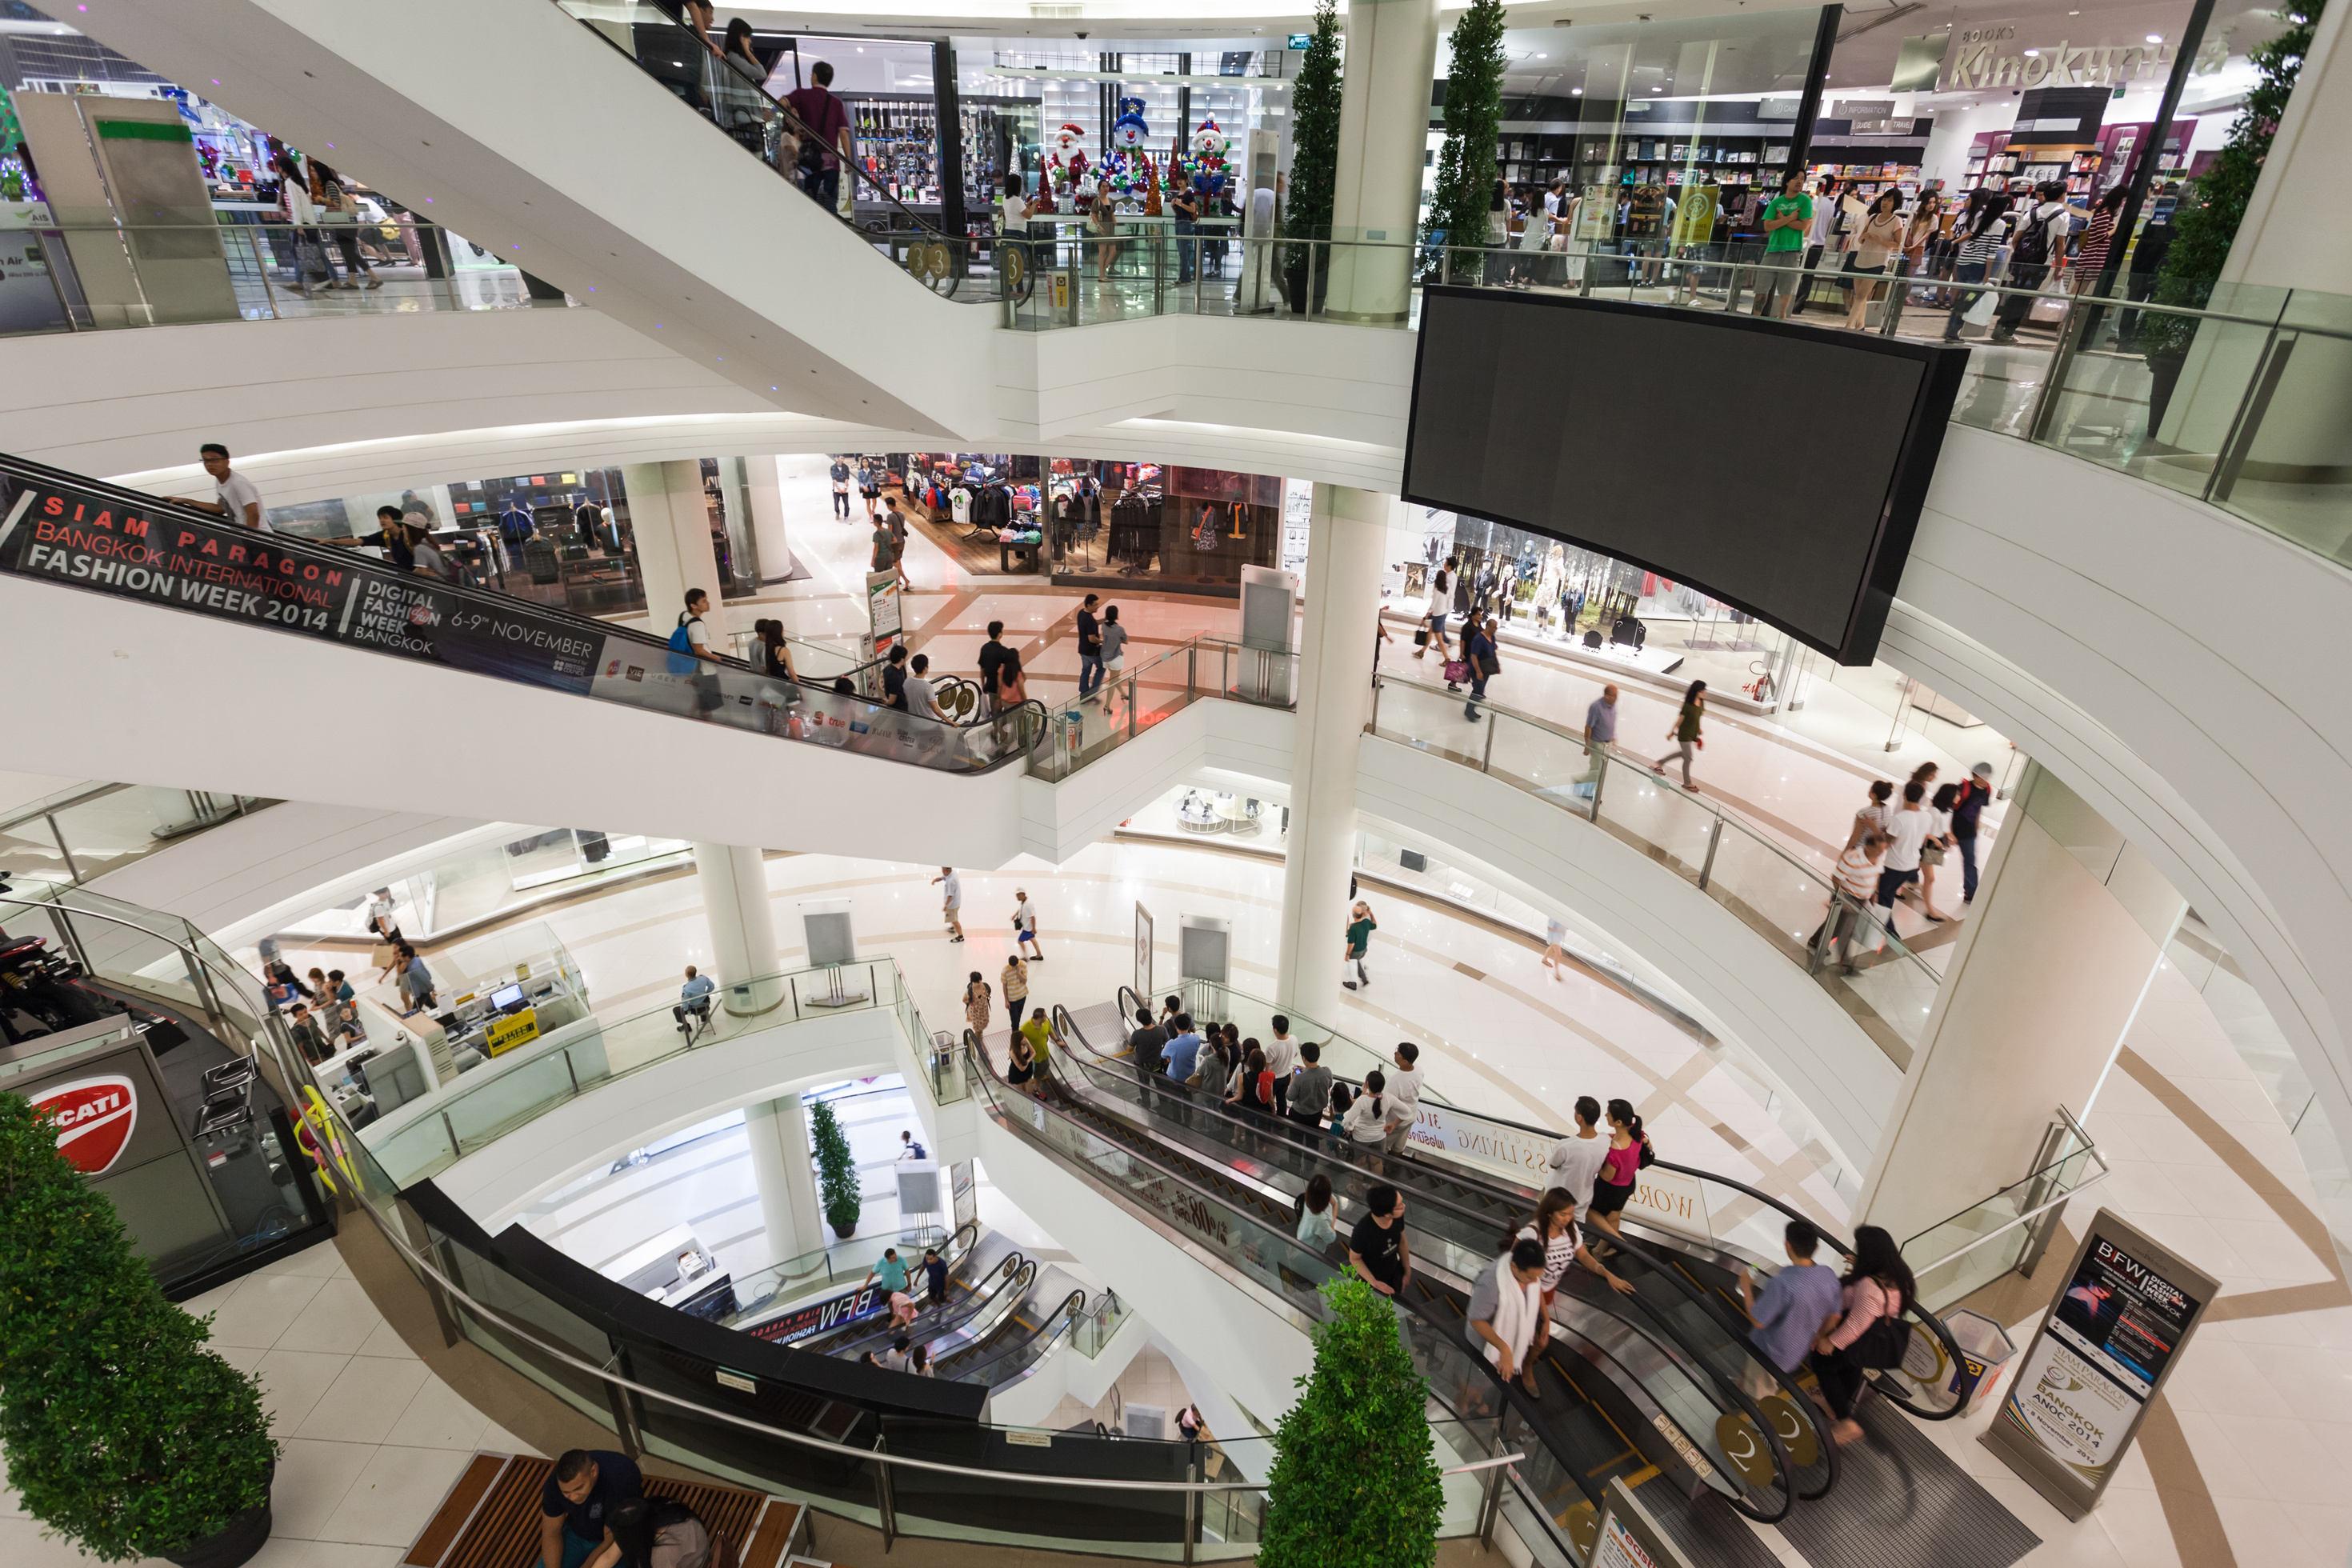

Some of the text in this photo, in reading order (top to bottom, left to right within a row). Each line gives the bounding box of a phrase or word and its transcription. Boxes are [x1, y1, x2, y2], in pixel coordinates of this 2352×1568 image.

[1962, 26, 2016, 42] BOOKS
[1848, 106, 1886, 114] INFORMATION
[1856, 121, 1872, 130] GUIDE
[7, 257, 23, 266] Air
[914, 247, 923, 270] 3
[934, 250, 943, 274] 3
[1008, 255, 1018, 279] 3
[44, 497, 342, 586] SIAM PARAGON
[35, 521, 332, 608] BANGKOK INTERNATIONAL
[28, 544, 328, 630] FASHION WEEK 2014
[368, 580, 433, 609] DIGITAL
[362, 612, 408, 635] WEEK
[354, 626, 434, 654] BANGKOK
[491, 620, 593, 658] NOVEMBER
[563, 667, 584, 677] COUNCIL
[565, 662, 586, 672] BRITISH
[630, 668, 642, 678] VIE
[651, 673, 677, 684] UBER
[962, 693, 969, 713] 2
[829, 716, 846, 728] true
[48, 1092, 120, 1129] CATI
[1018, 1270, 1029, 1282] M
[2094, 1258, 2138, 1288] FASHION WEEK 2014
[2101, 1275, 2143, 1307] SHOW SCHEDULE
[2146, 1285, 2170, 1304] WEEK
[2150, 1275, 2185, 1301] DIGITAL
[2142, 1290, 2182, 1318] BANGKOK
[2057, 1346, 2130, 1405] SIAM PARAGON
[2077, 1377, 2093, 1390] ANOC
[2032, 1394, 2066, 1422] ANOC
[2068, 1421, 2099, 1449] 2014
[2036, 1382, 2105, 1441] BANGKOK
[1778, 1410, 1800, 1453] 2
[2037, 1415, 2074, 1447] November
[2077, 1449, 2095, 1465] 2014
[1727, 1429, 1755, 1472] 2
[1699, 1463, 1710, 1474] 42
[1607, 1534, 1615, 1546] For
